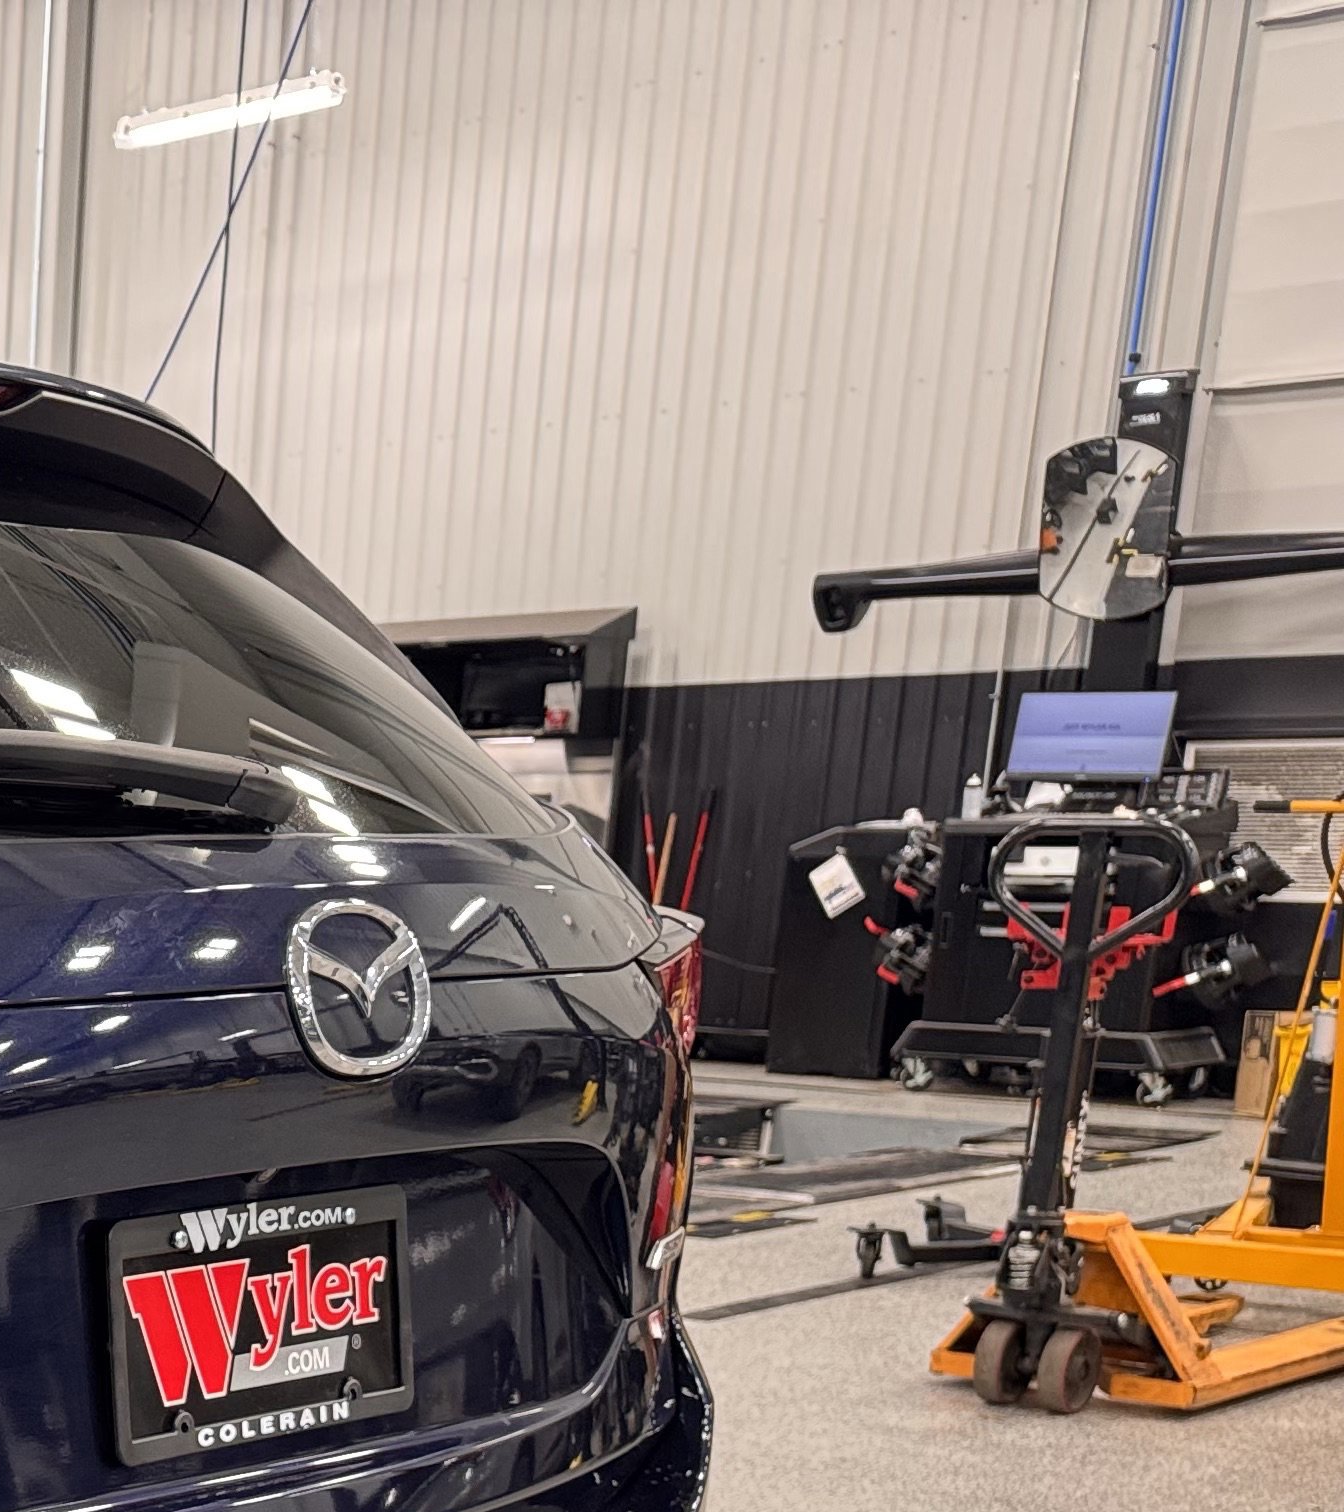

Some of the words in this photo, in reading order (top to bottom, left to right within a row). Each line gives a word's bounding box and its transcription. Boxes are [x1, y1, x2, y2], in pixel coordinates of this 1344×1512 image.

[123, 1245, 386, 1406] Wyler
[284, 1348, 330, 1374] .COM
[198, 1402, 349, 1447] COLERAIN
